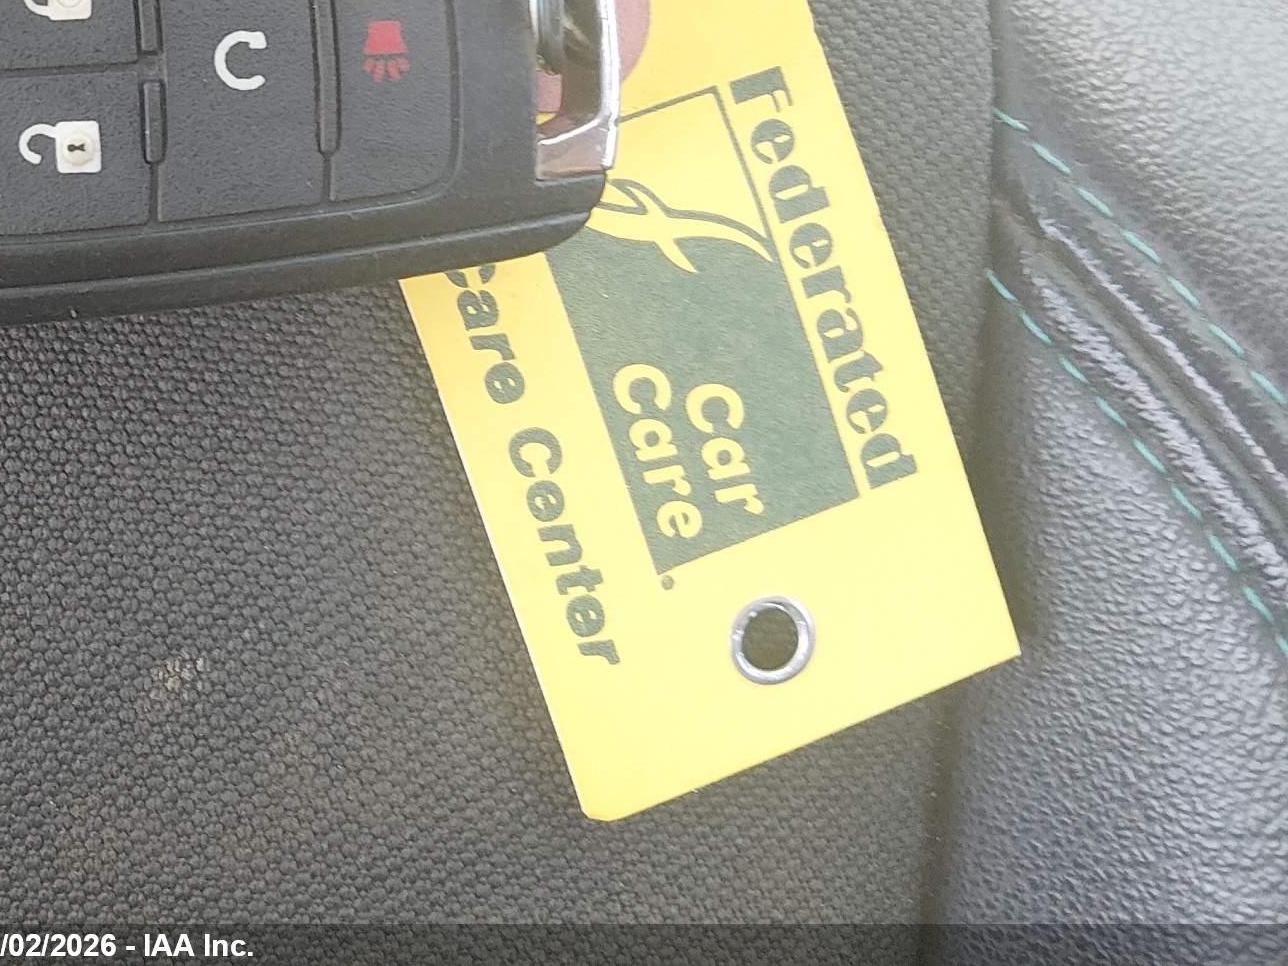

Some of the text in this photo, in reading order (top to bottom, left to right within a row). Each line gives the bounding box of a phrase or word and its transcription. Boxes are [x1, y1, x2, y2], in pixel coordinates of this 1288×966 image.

[729, 66, 917, 490] Federated
[507, 426, 620, 666] Center
[611, 363, 703, 540] Care
[685, 382, 765, 516] Car
